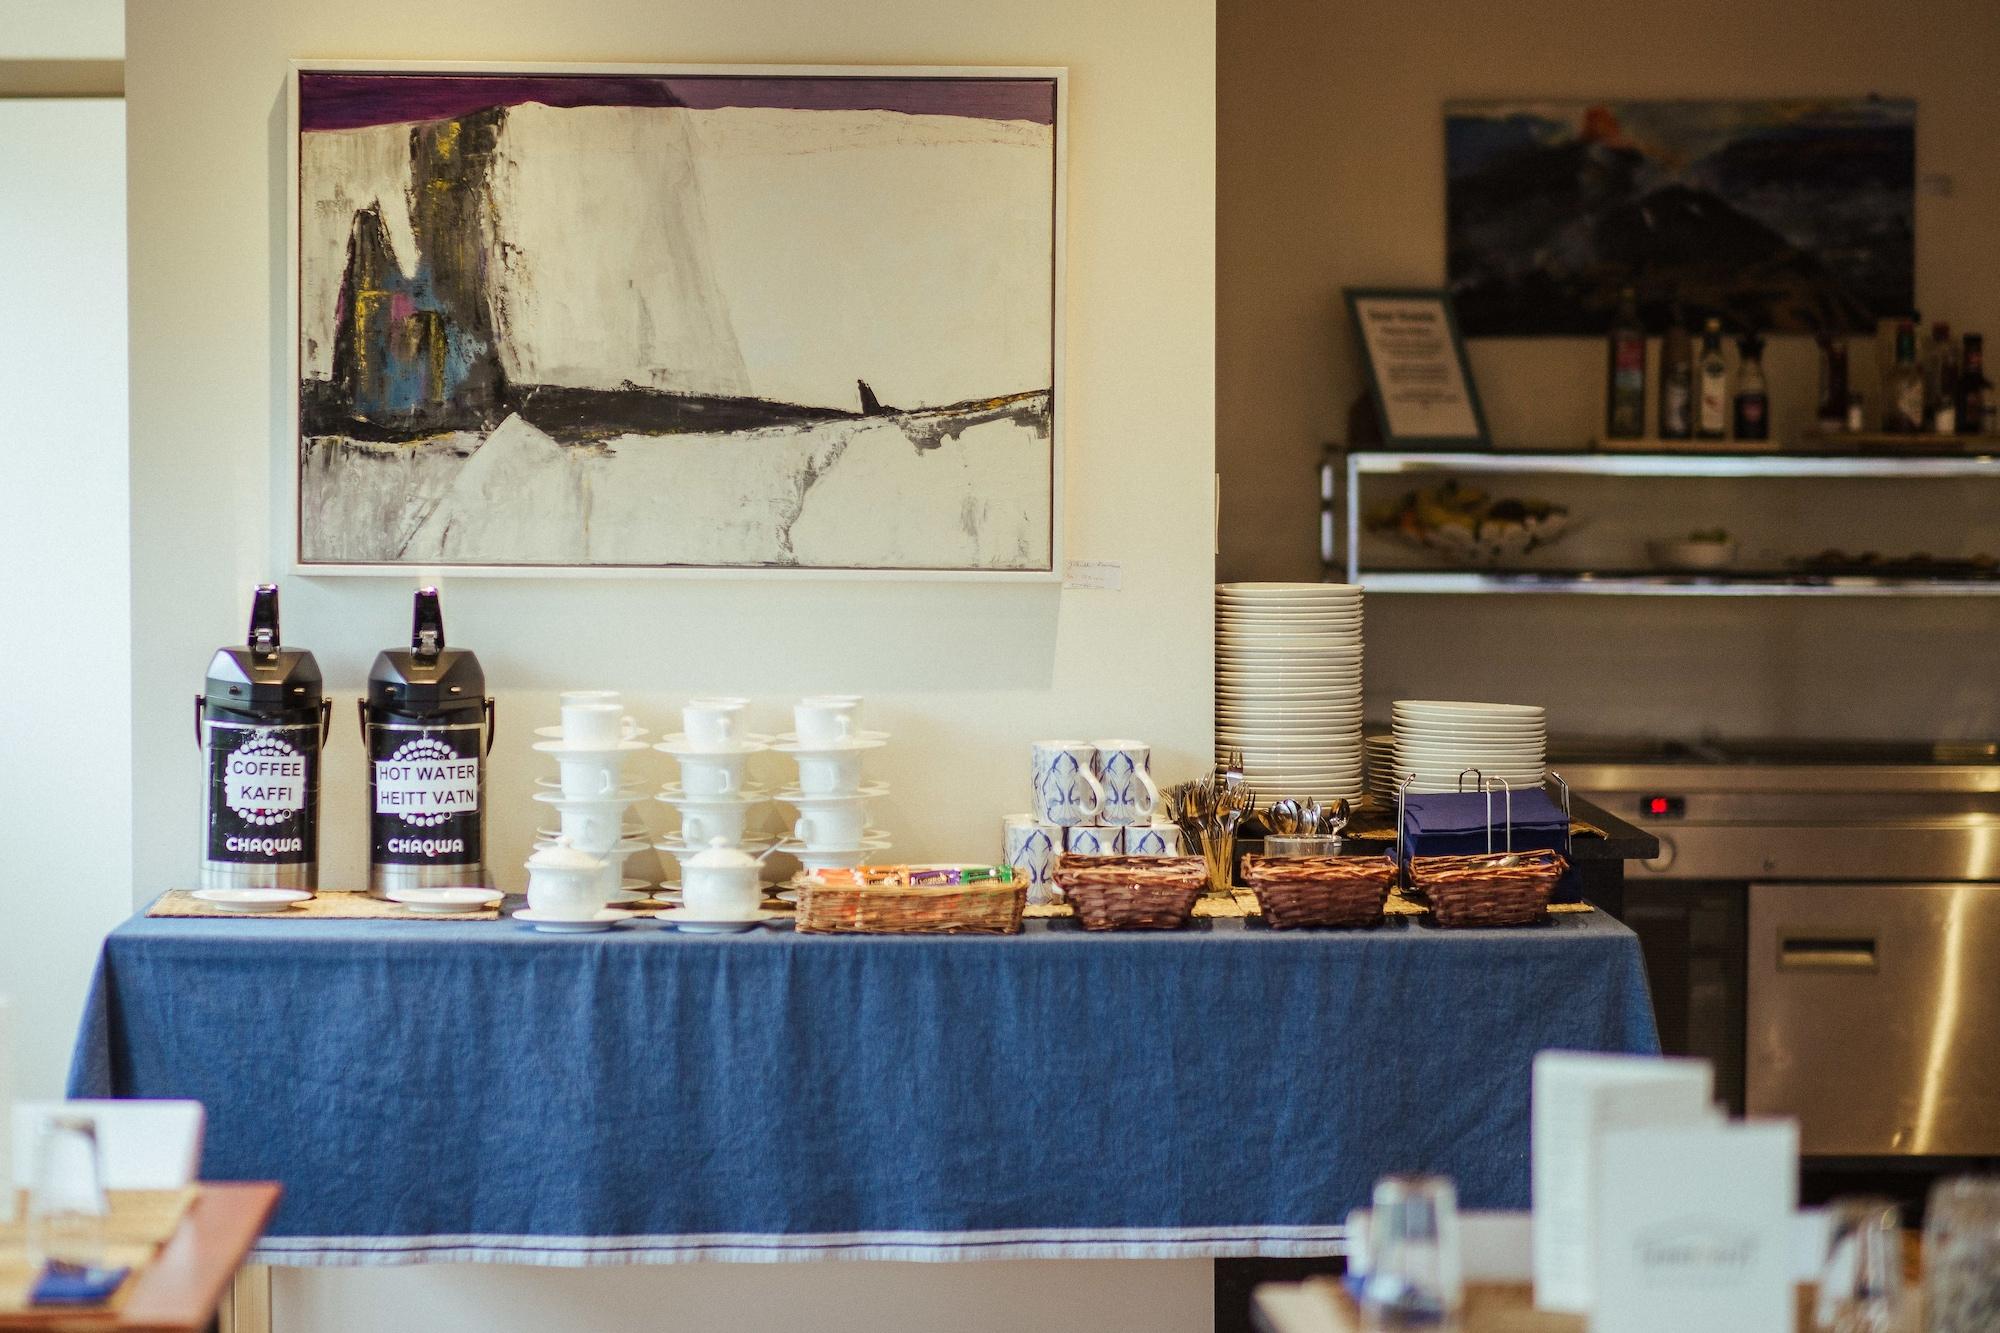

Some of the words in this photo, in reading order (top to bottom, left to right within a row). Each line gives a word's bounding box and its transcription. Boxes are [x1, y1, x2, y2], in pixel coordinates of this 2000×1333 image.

[232, 761, 301, 777] COFFEE
[379, 766, 411, 781] HOT
[416, 765, 476, 781] WATER
[241, 786, 292, 801] KAFFI
[380, 791, 427, 805] HEITT
[433, 790, 475, 805] VATN
[225, 837, 302, 856] CHAQWA
[387, 838, 465, 857] CHAQWA
